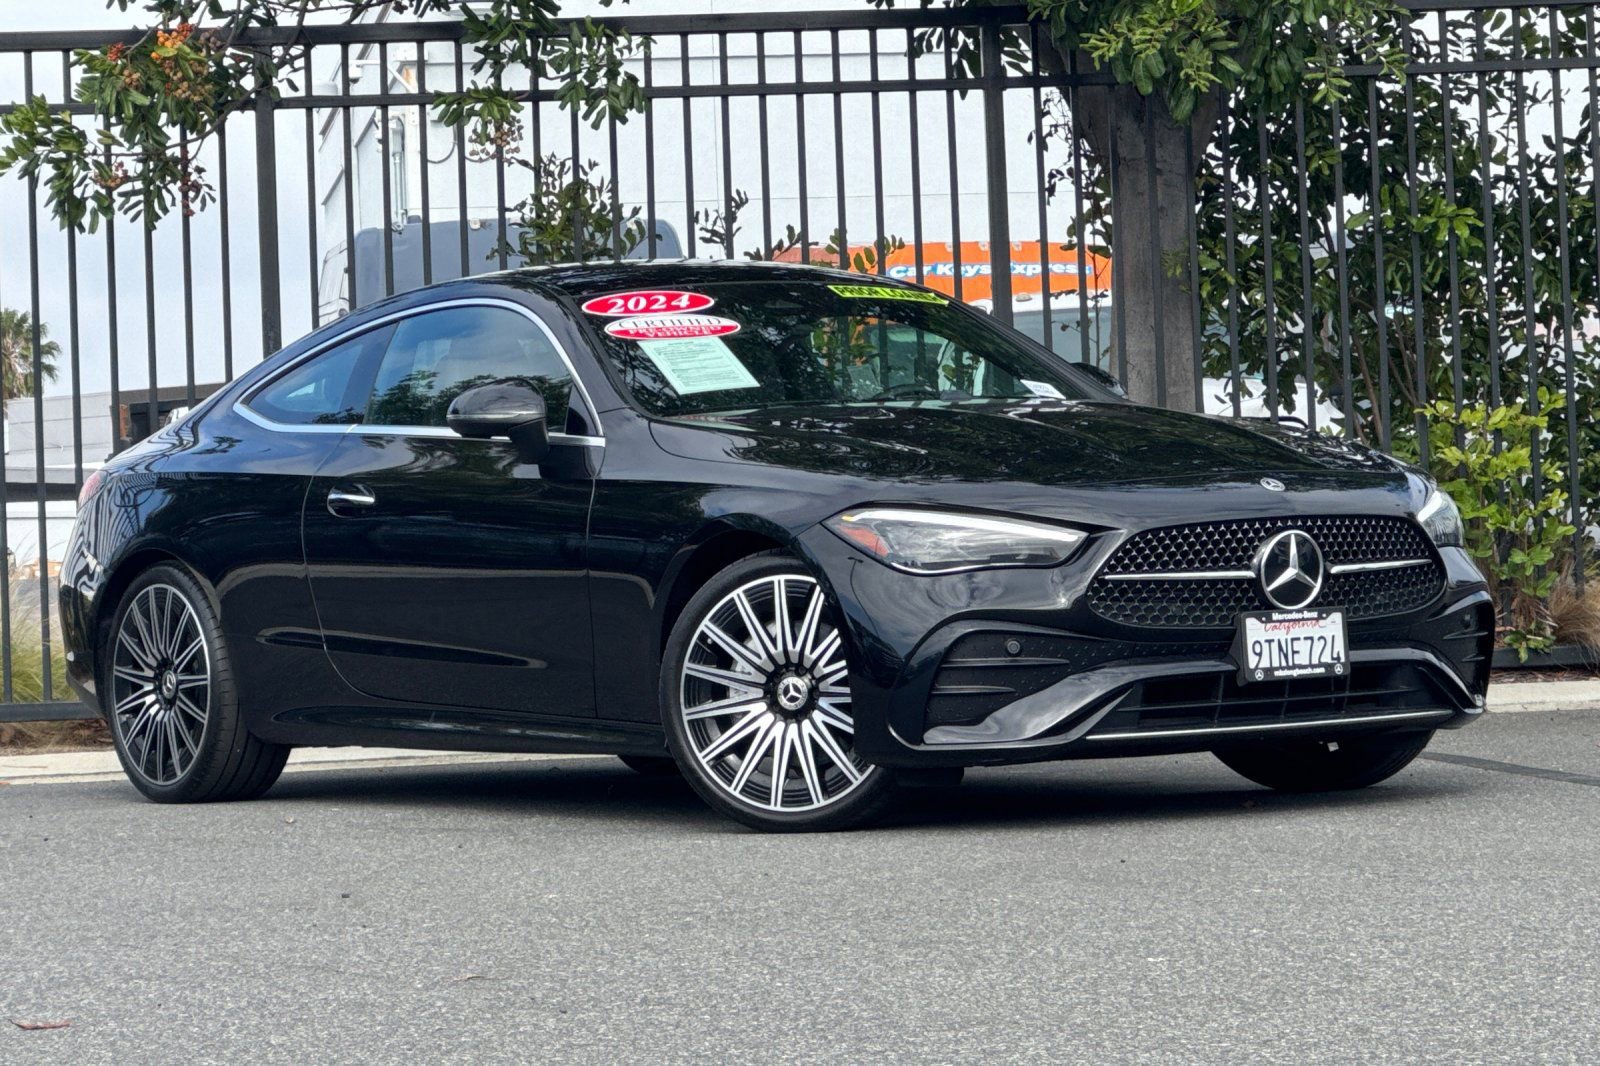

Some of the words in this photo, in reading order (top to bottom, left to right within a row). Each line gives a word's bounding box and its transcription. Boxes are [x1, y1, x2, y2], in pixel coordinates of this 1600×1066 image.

[889, 265, 932, 278] Car
[607, 294, 691, 313] 2024
[619, 317, 722, 329] CERTIFIED
[628, 325, 722, 335] PRE-OWNED
[645, 329, 713, 337] VEHICLE
[1271, 611, 1318, 620] Mercedes-Benz
[1264, 620, 1326, 635] California
[1252, 634, 1341, 669] 9TNE724
